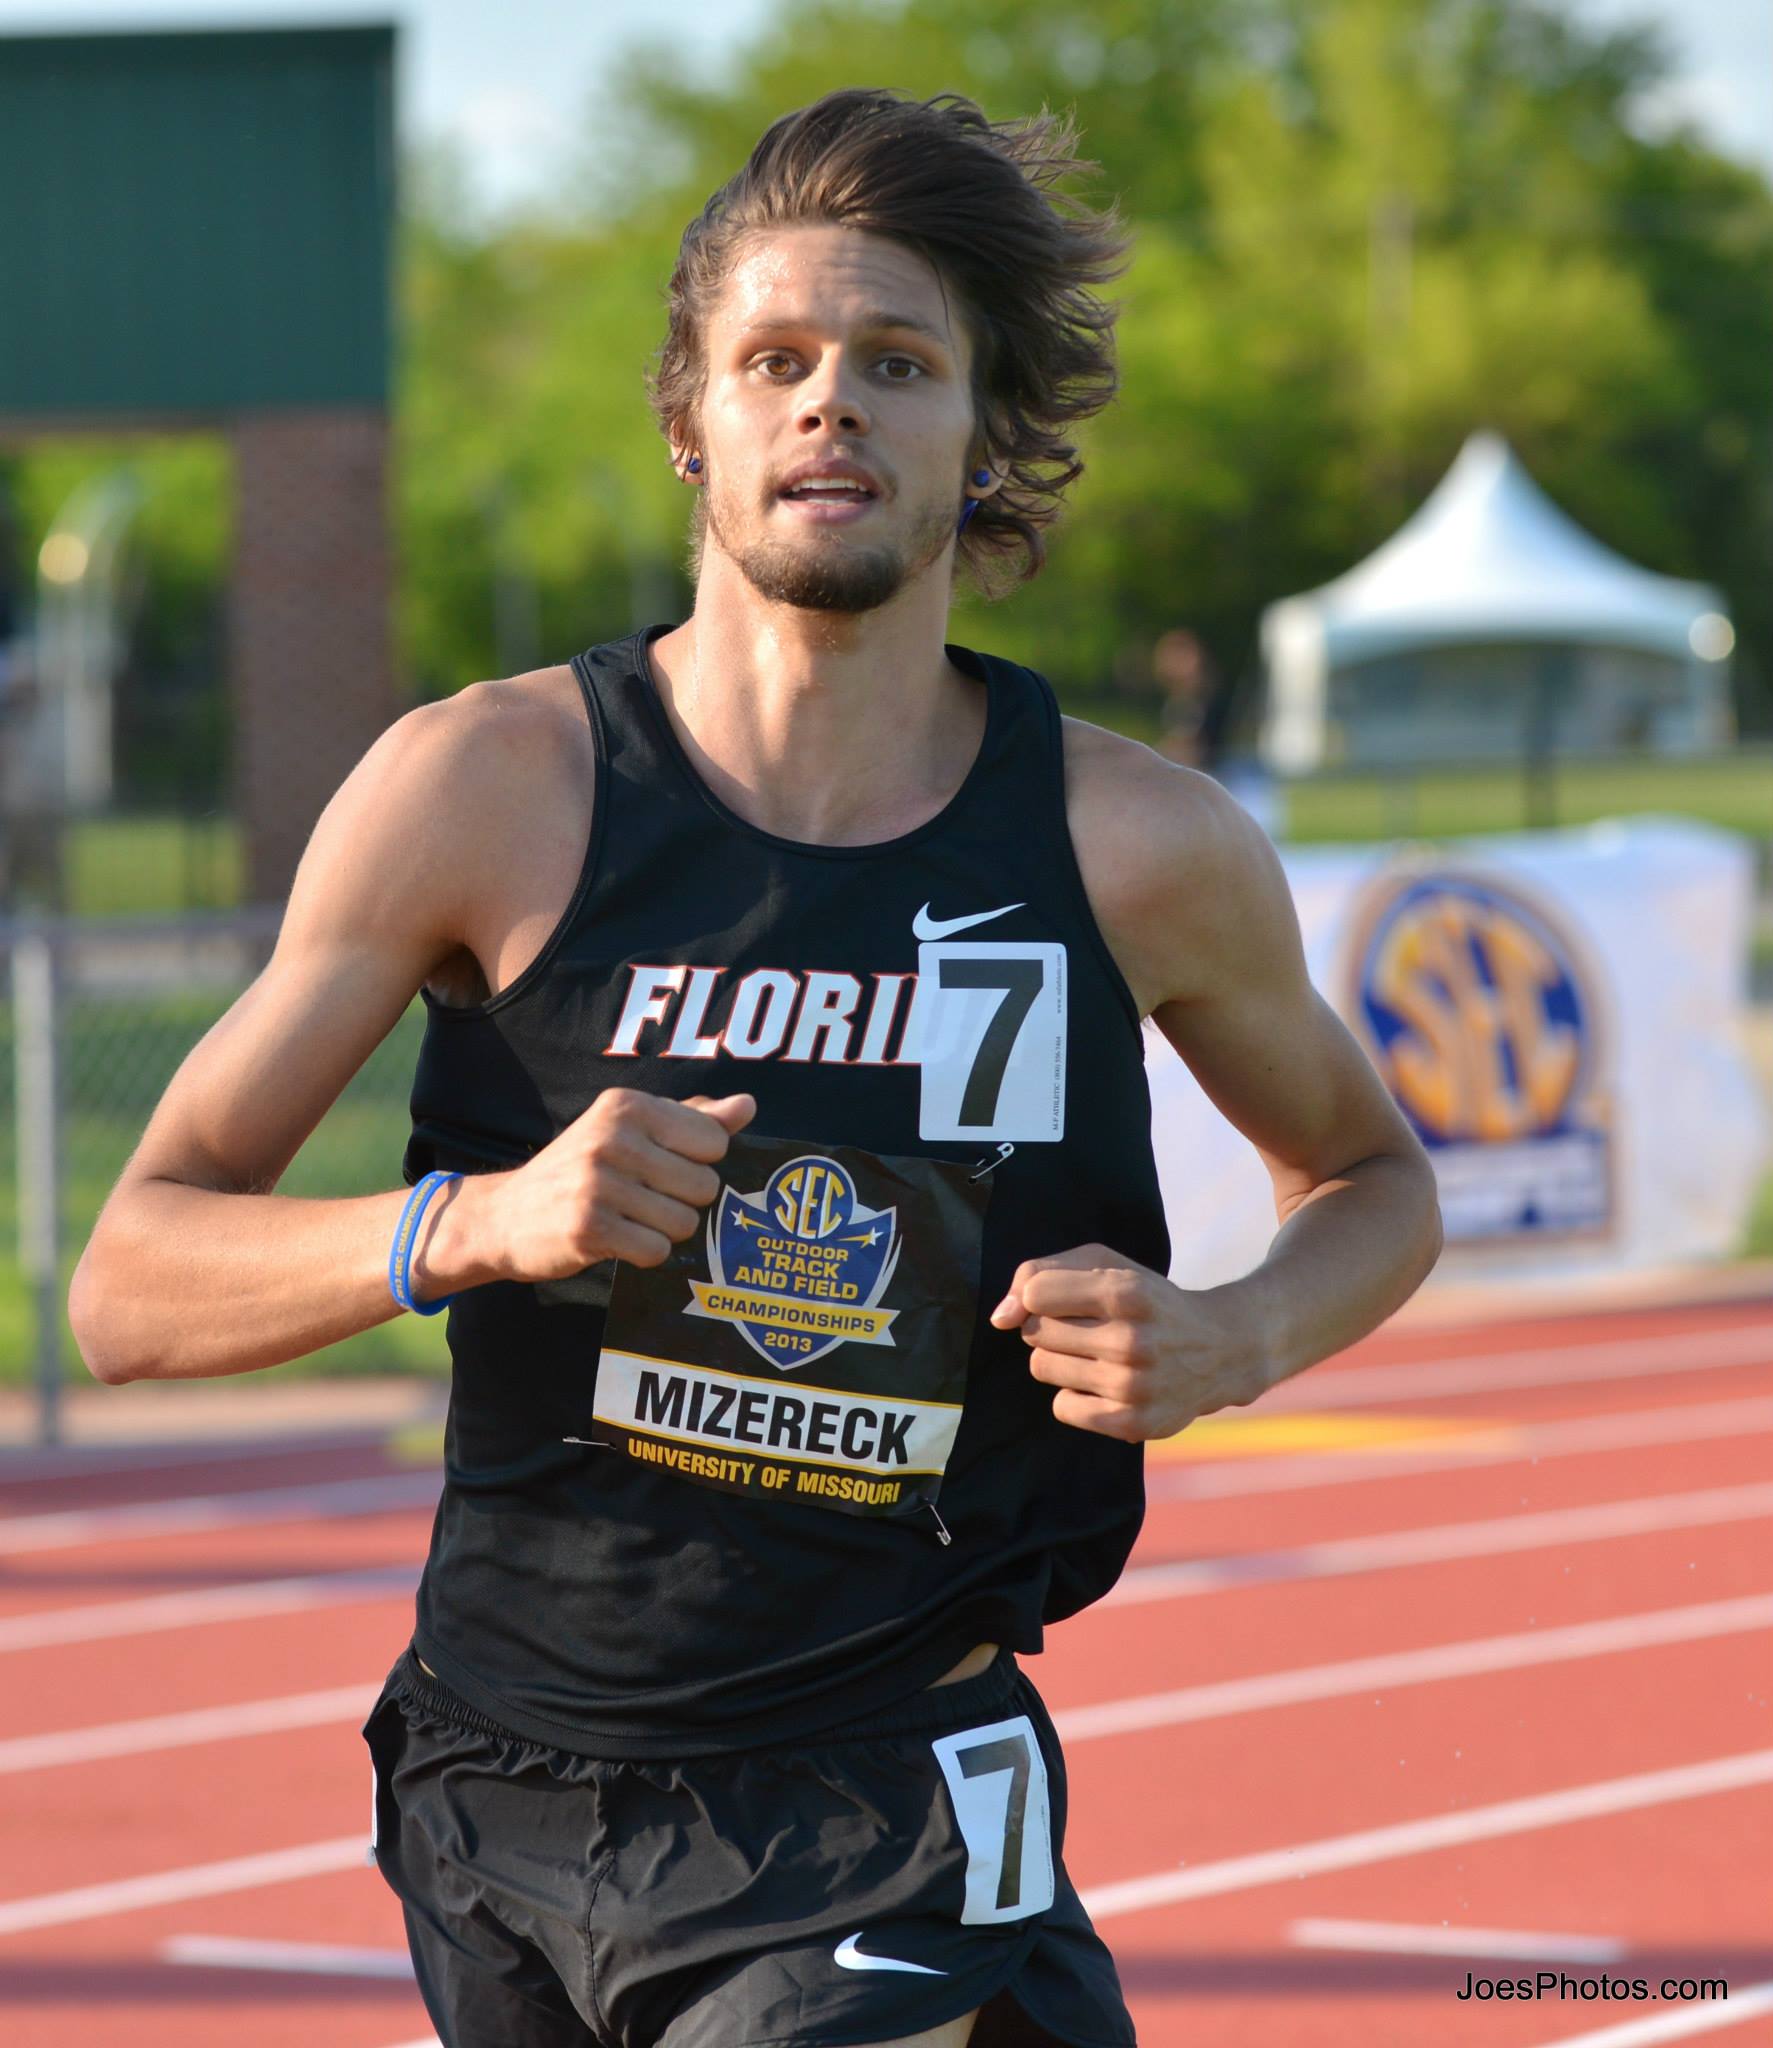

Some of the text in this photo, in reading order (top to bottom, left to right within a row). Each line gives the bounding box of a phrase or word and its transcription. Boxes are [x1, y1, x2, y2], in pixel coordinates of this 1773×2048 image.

[602, 963, 1022, 1066] FLORI
[938, 958, 1044, 1127] 7
[774, 1166, 846, 1240] SEC
[394, 1255, 404, 1277] SEC
[756, 1236, 849, 1262] OUTDOOR
[762, 1251, 841, 1280] TRACK
[734, 1266, 859, 1300] AND FIELD
[706, 1294, 876, 1333] CHAMPIONSHIPS
[763, 1331, 813, 1352] 2013
[634, 1371, 917, 1465] MIZERECK
[627, 1437, 901, 1505] UNIVERSITY OF MISSOURI
[954, 1732, 1032, 1911] 7
